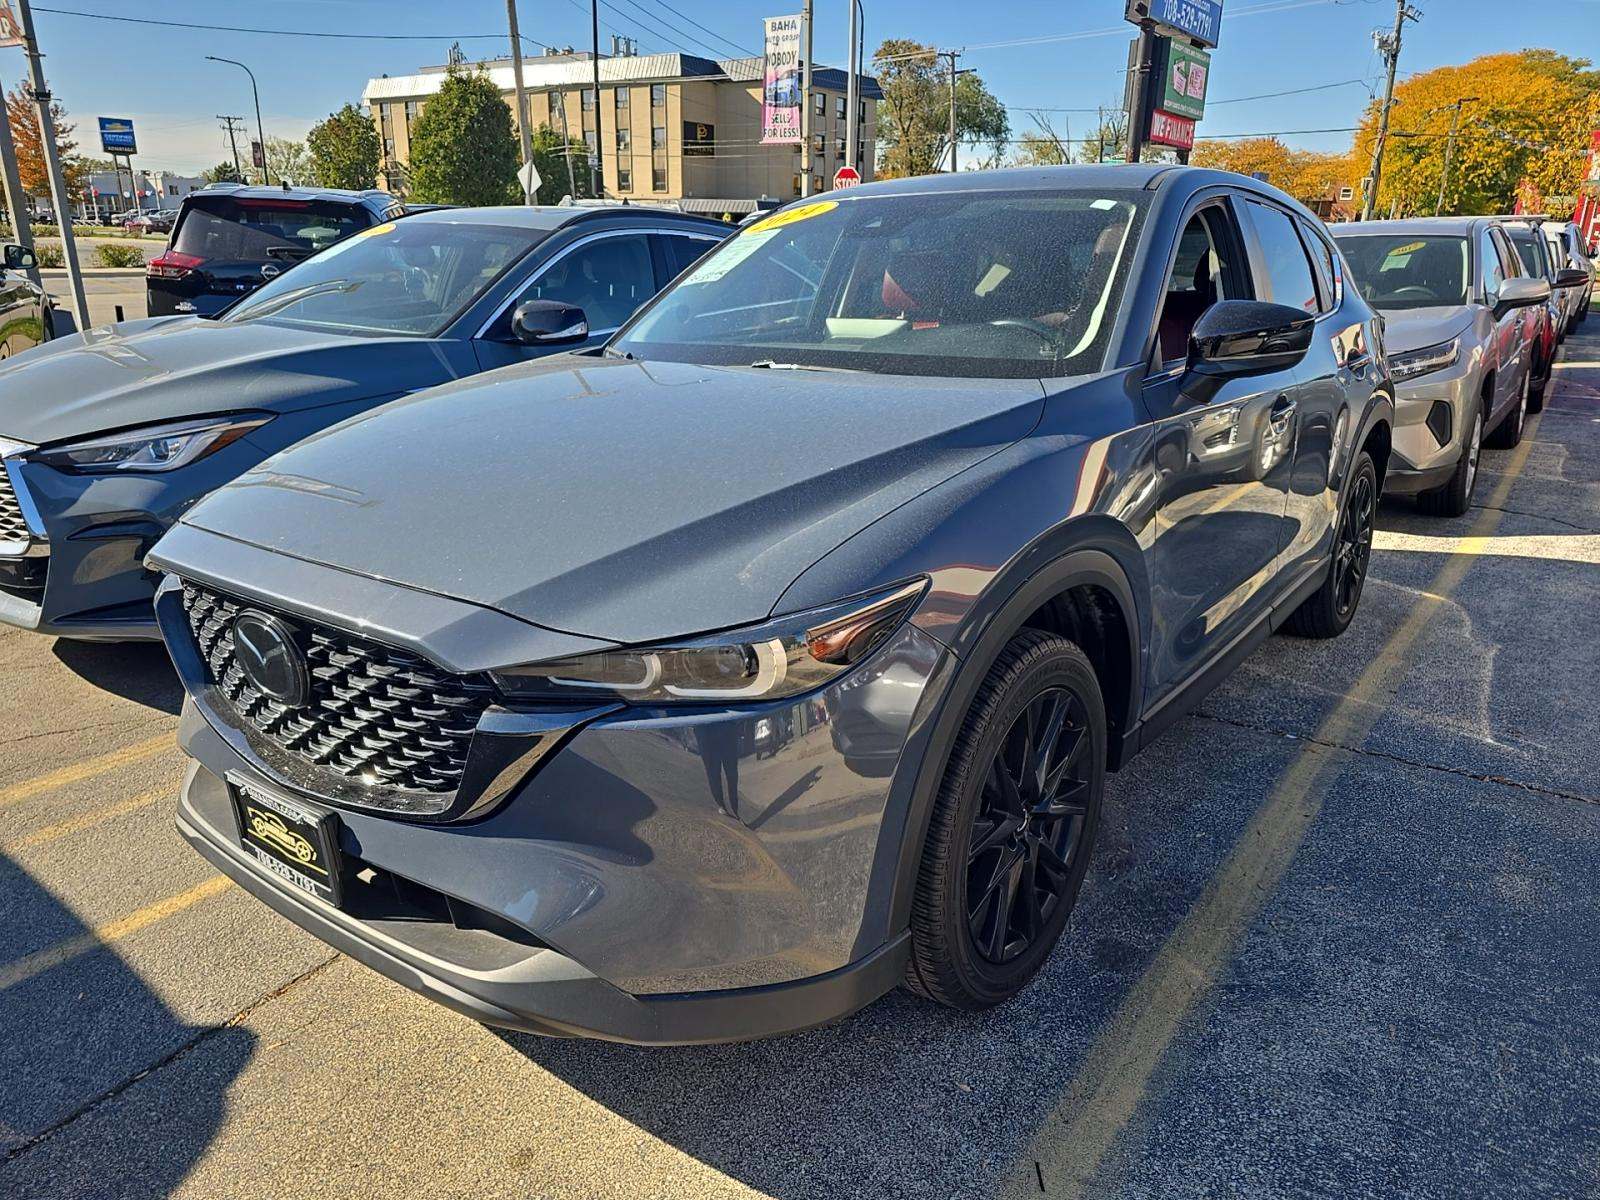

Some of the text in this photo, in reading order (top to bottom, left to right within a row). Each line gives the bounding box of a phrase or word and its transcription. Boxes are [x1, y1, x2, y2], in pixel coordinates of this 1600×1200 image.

[771, 20, 797, 32] BAHA
[766, 51, 797, 66] NOBODY
[772, 114, 791, 124] SELLS
[764, 129, 778, 138] FOR
[1153, 112, 1194, 145] WE FINANCE
[835, 178, 859, 191] STOP
